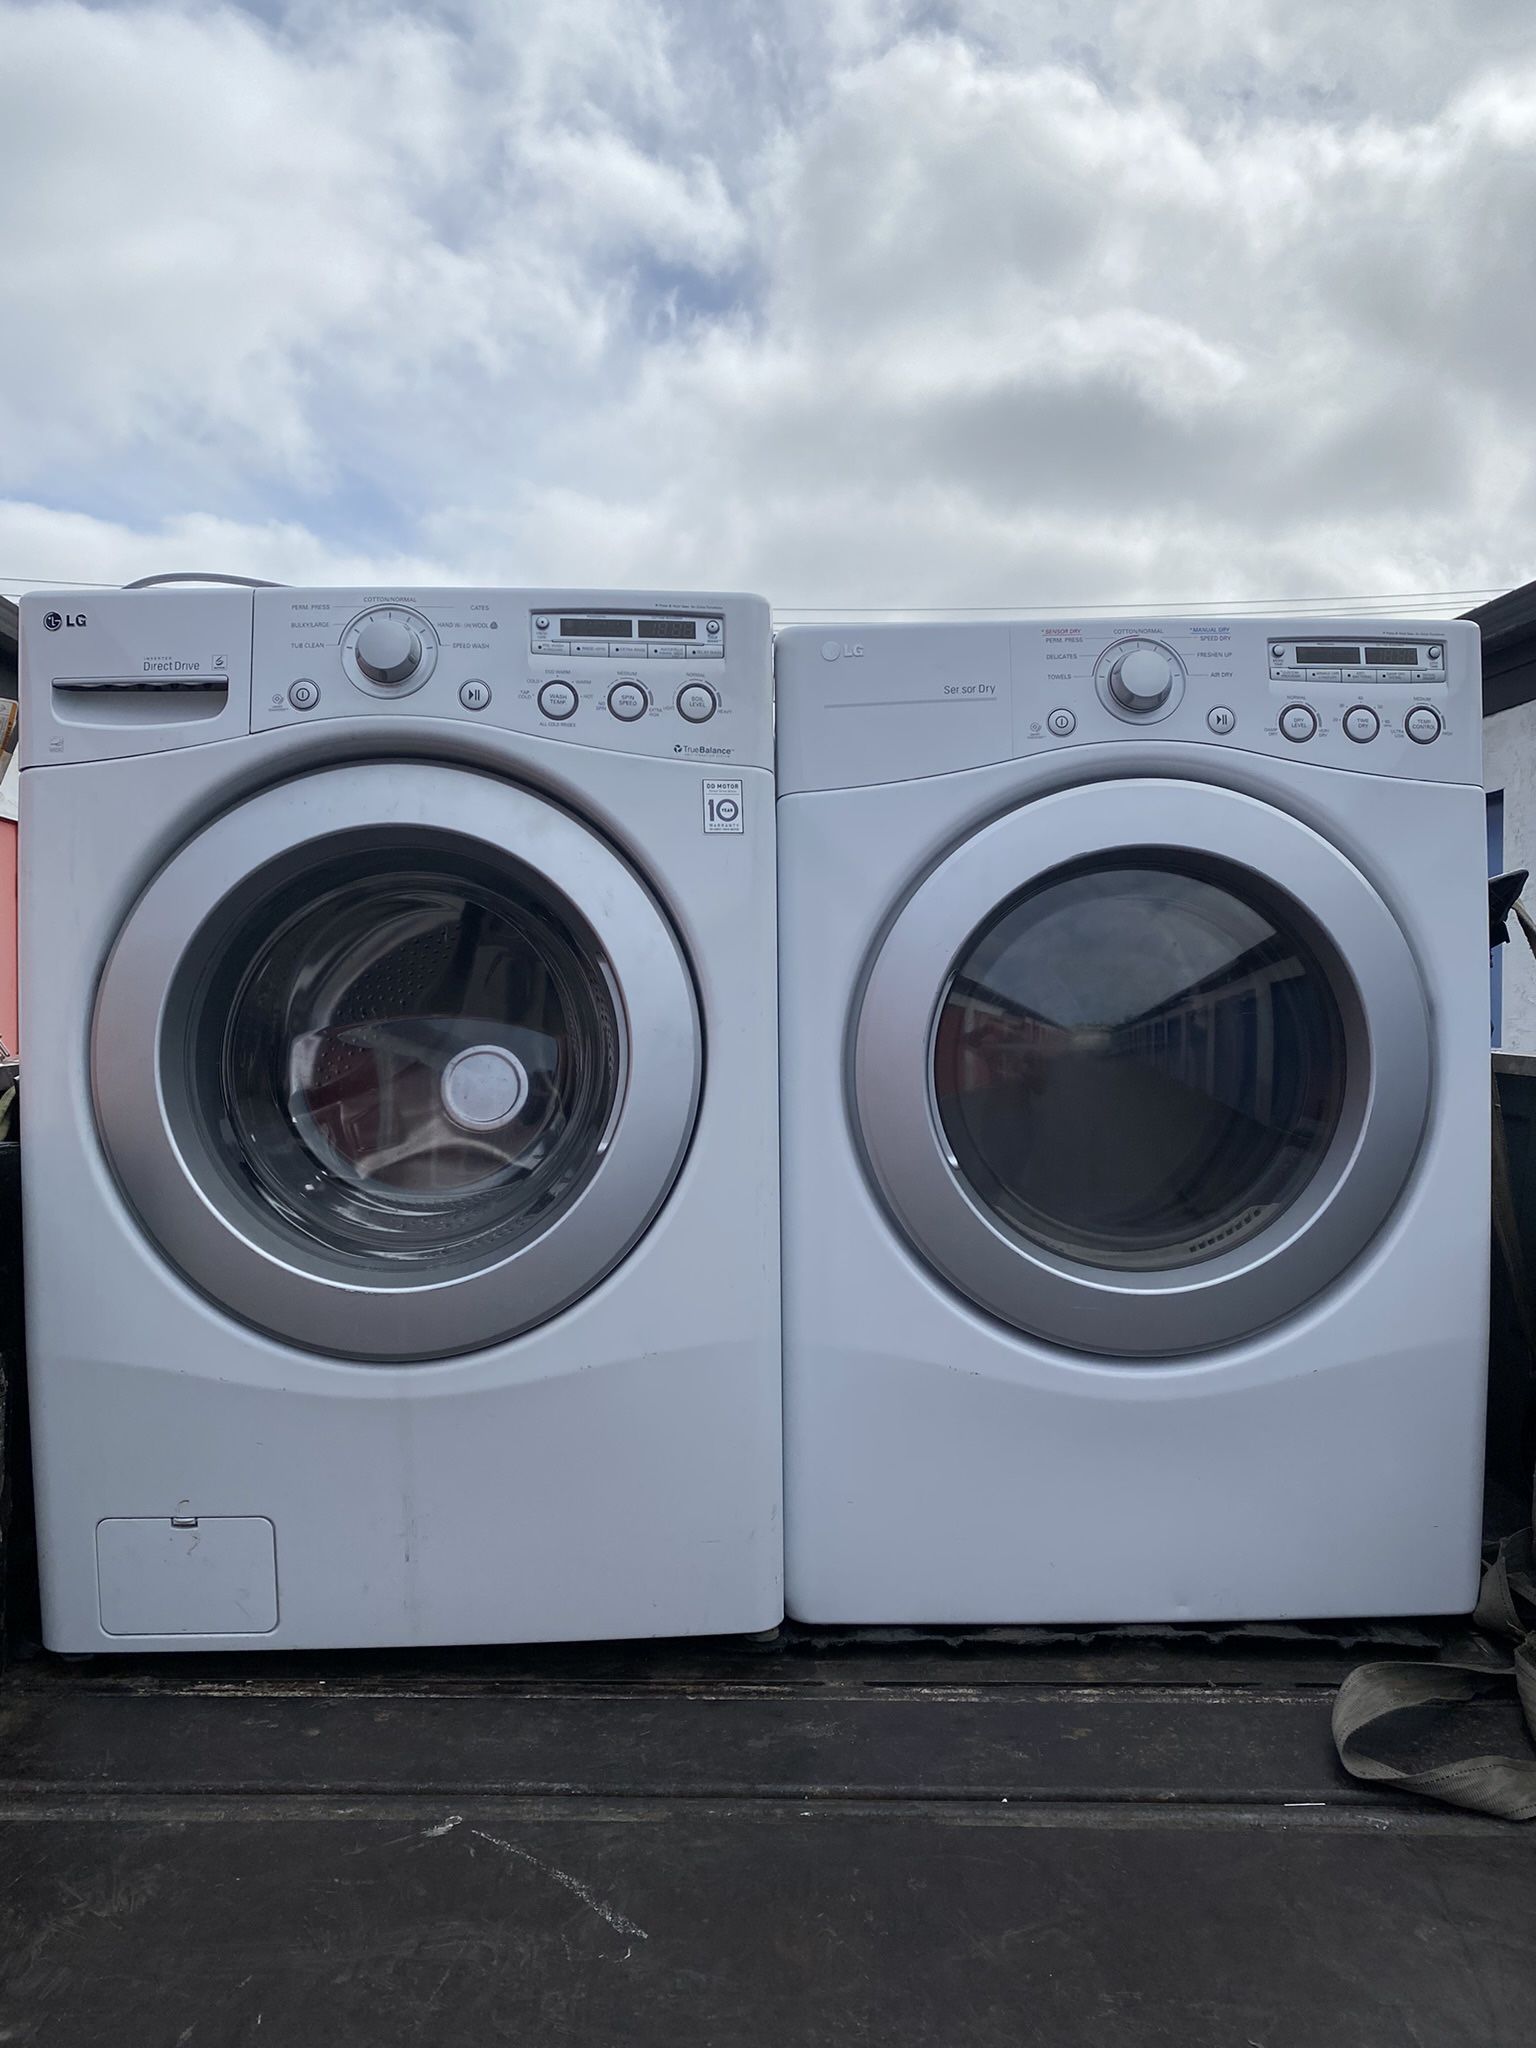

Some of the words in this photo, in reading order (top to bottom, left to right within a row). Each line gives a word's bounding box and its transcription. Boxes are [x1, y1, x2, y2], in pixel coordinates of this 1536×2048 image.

[66, 614, 87, 627] LG
[843, 644, 864, 658] LG
[143, 661, 173, 671] Direct
[174, 661, 200, 671] Drive
[978, 683, 997, 695] Dry
[708, 799, 739, 822] 10
